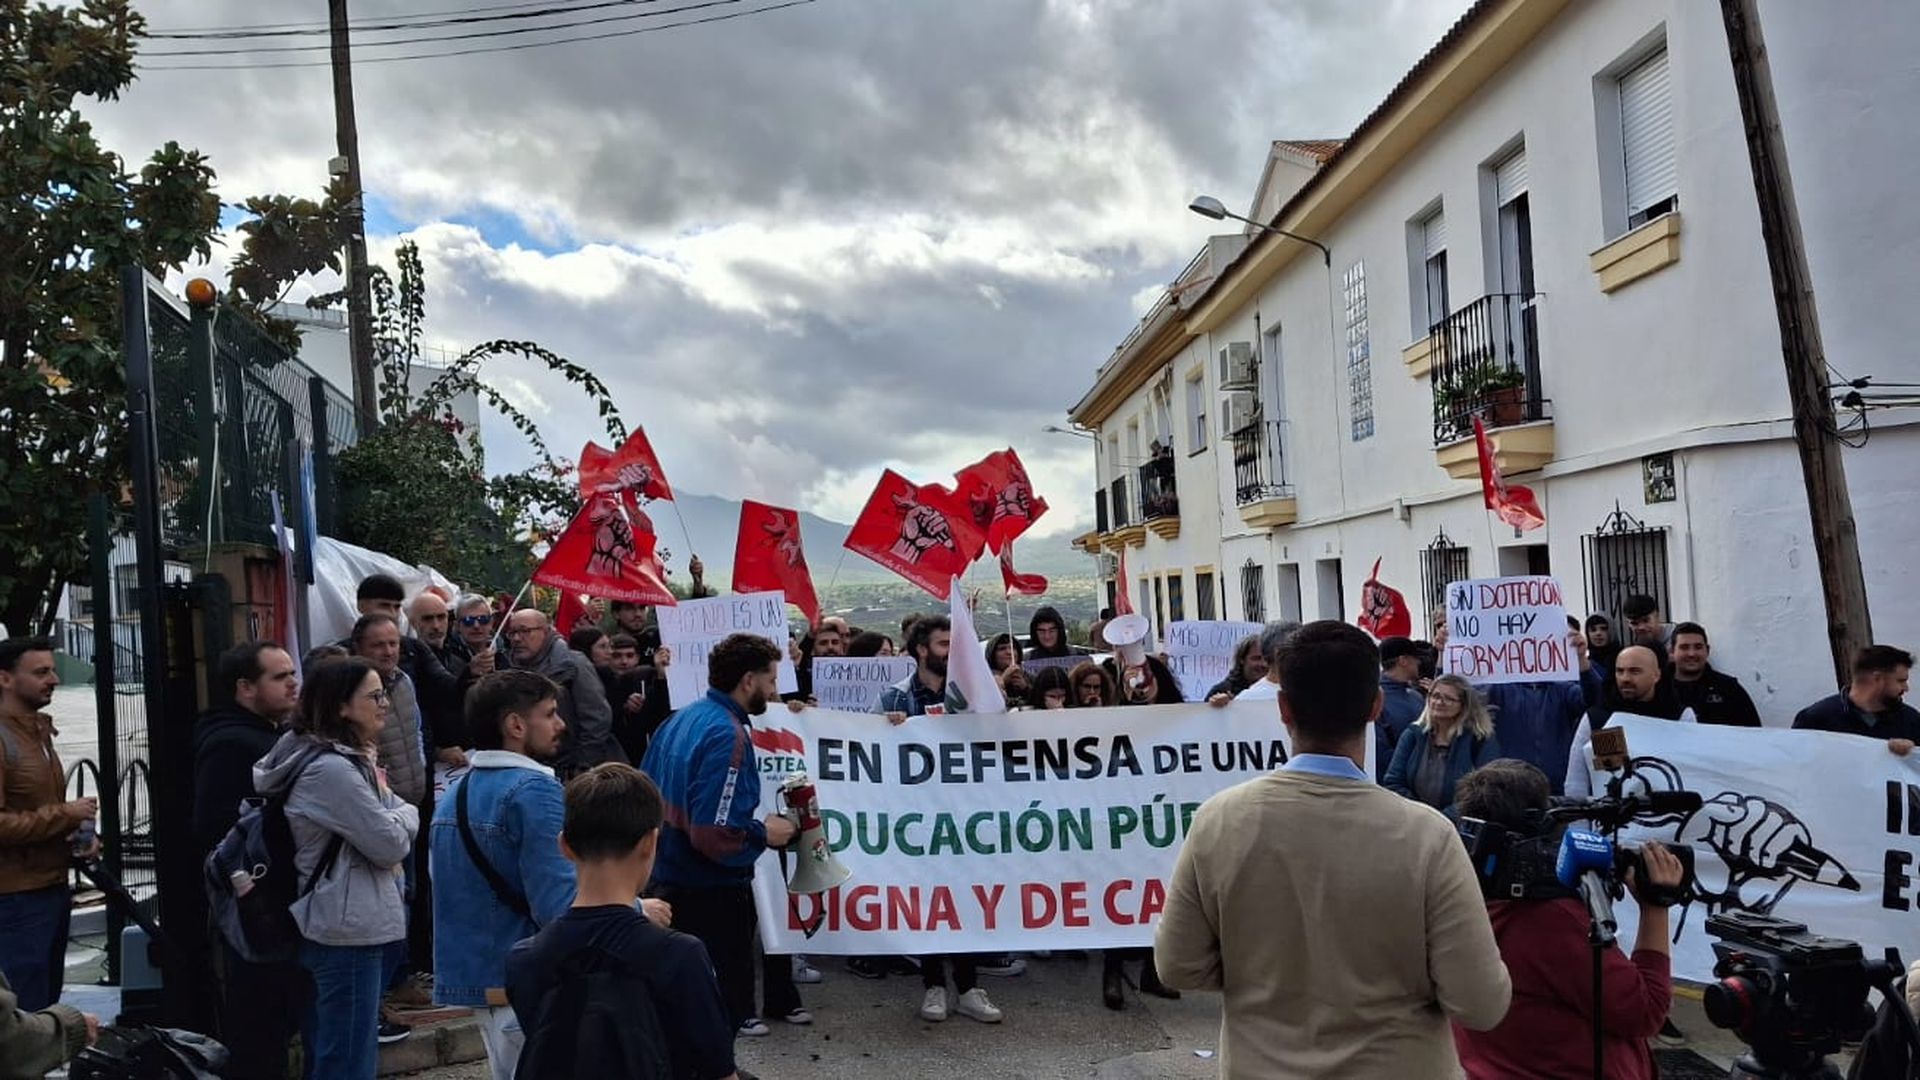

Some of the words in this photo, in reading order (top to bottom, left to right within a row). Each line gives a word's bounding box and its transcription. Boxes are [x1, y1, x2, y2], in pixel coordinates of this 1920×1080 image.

[1479, 577, 1563, 610] DOTACIÓN
[731, 600, 752, 630] ES
[759, 597, 782, 628] UN
[1455, 615, 1480, 638] NO
[1497, 611, 1537, 636] HAY
[815, 658, 891, 681] FORMACIÓN
[1447, 634, 1569, 677] FORMACIÓN
[818, 737, 883, 783] EN
[898, 734, 1143, 785] DEFENSA
[1152, 743, 1202, 774] DE
[1211, 740, 1289, 772] UNA
[786, 799, 1094, 858] DUCACIÓN
[787, 884, 963, 932] DIGNA
[971, 884, 1006, 931] Y
[1020, 881, 1090, 929] DE
